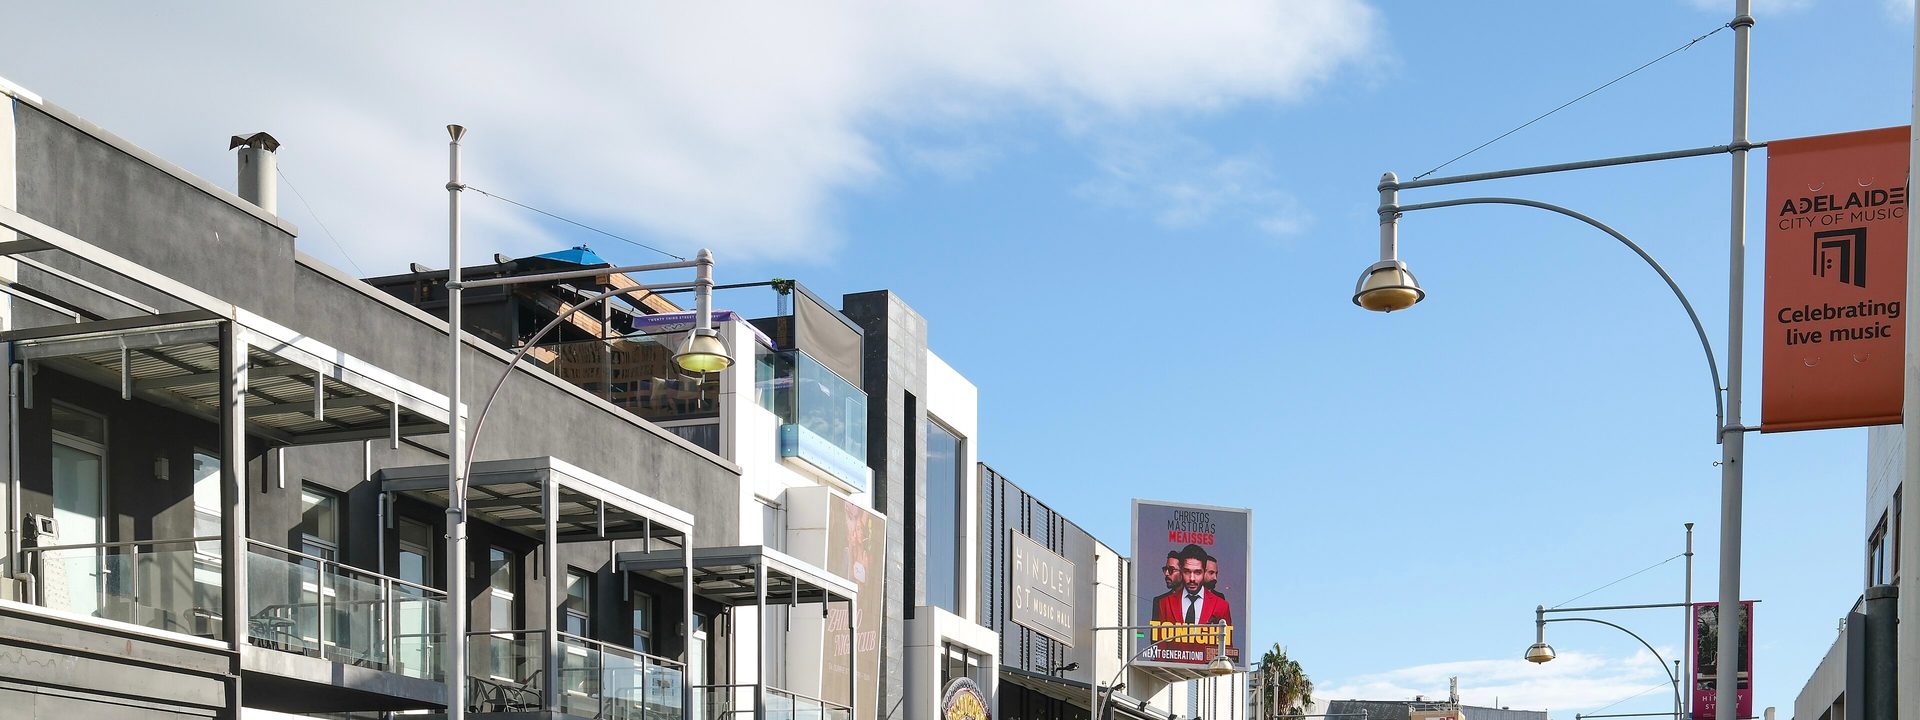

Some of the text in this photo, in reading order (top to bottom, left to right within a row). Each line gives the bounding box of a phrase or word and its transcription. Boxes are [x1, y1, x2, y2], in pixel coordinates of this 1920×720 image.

[1780, 187, 1904, 216] ADELAIDE
[1779, 207, 1904, 231] CITY OF MUSIC
[1777, 299, 1901, 324] Celebrating
[1786, 321, 1892, 346] live music
[1167, 520, 1216, 535] MASTORAS
[1173, 509, 1210, 524] CHRISTOS
[1016, 546, 1072, 598] HINDLEY
[1016, 584, 1071, 629] ST MUSIC HALL
